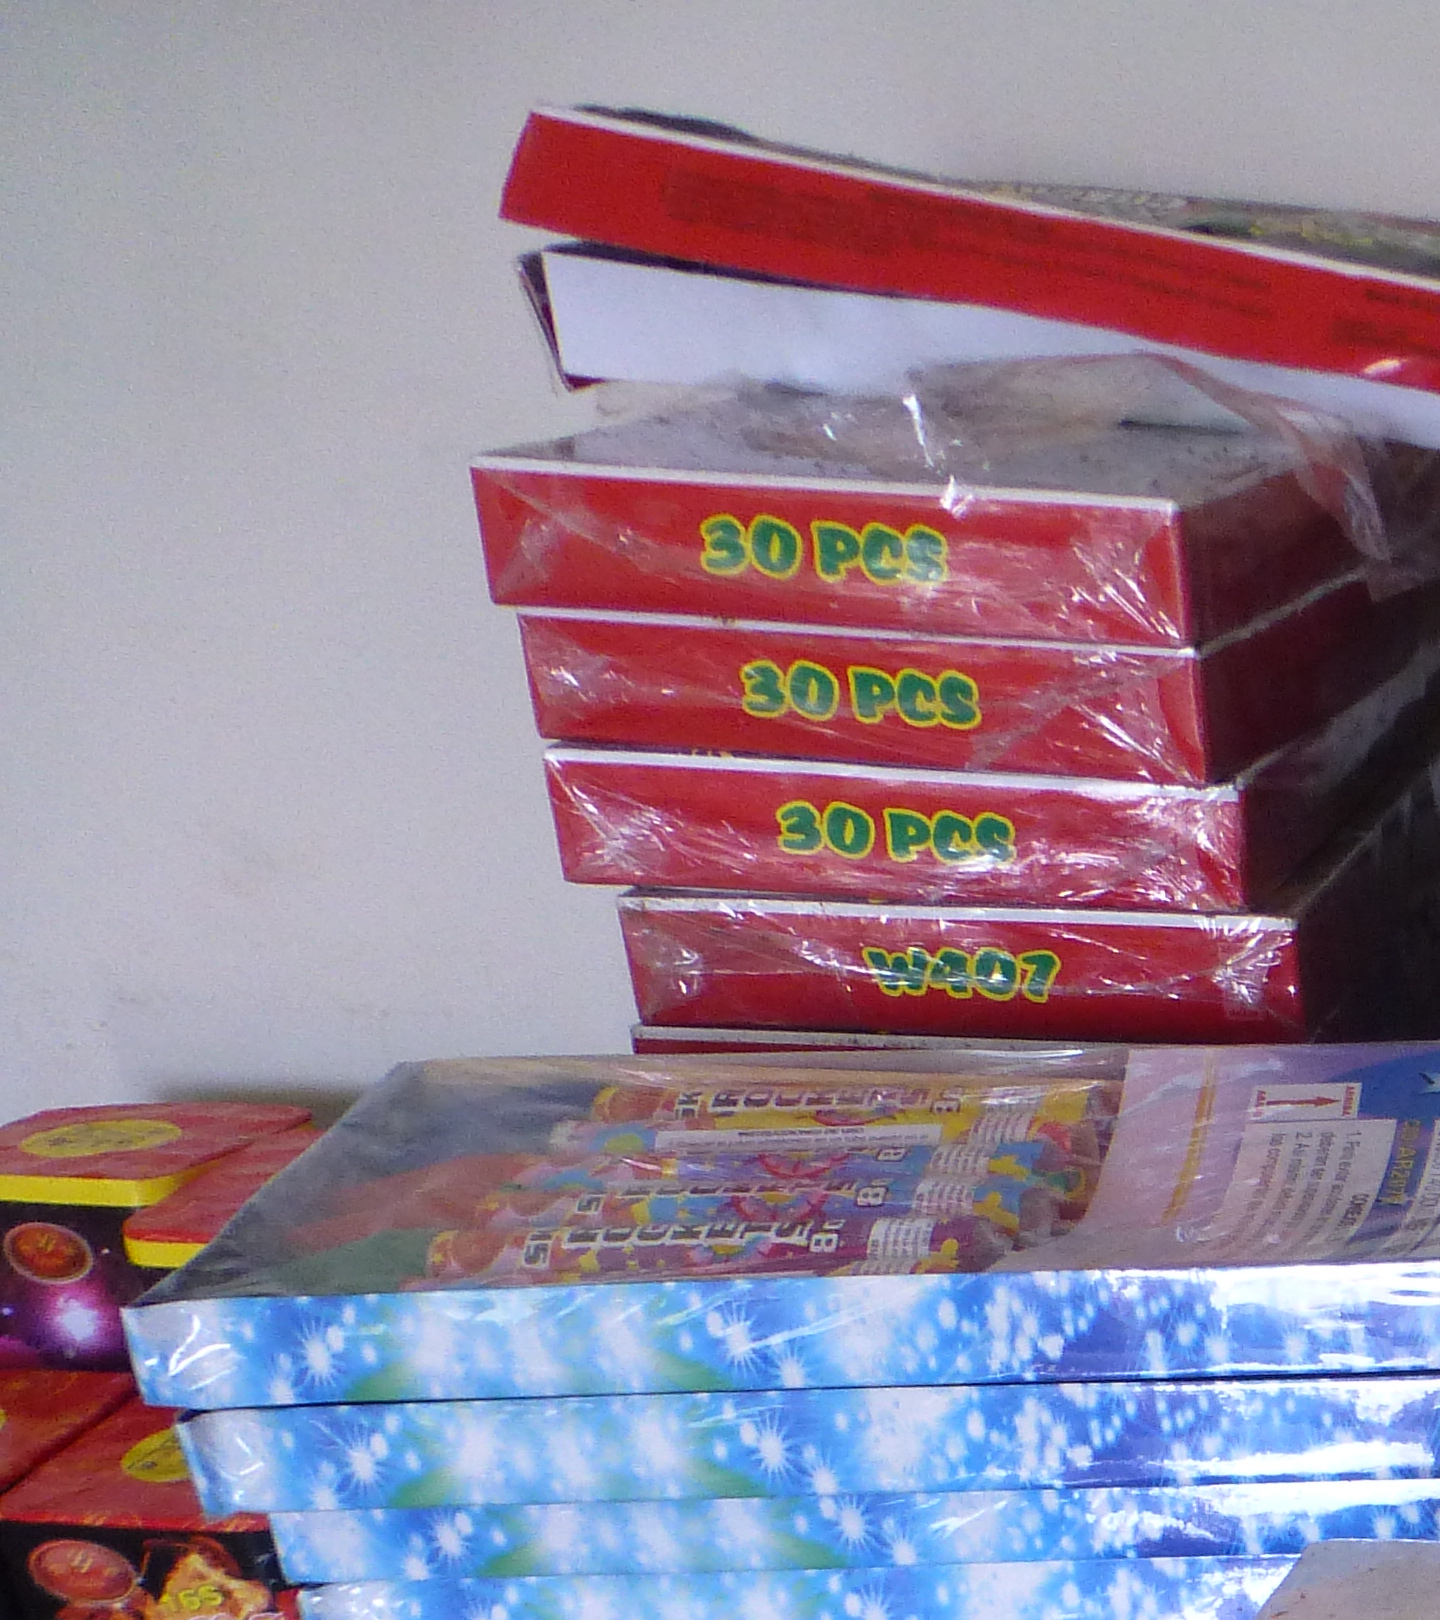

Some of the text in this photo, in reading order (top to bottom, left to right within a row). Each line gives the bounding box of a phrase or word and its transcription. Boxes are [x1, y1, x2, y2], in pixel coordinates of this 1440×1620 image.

[699, 513, 949, 588] 30 PCS
[740, 659, 982, 730] 30 PCS
[777, 800, 1017, 865] 30 PCS
[865, 945, 1062, 1003] W407
